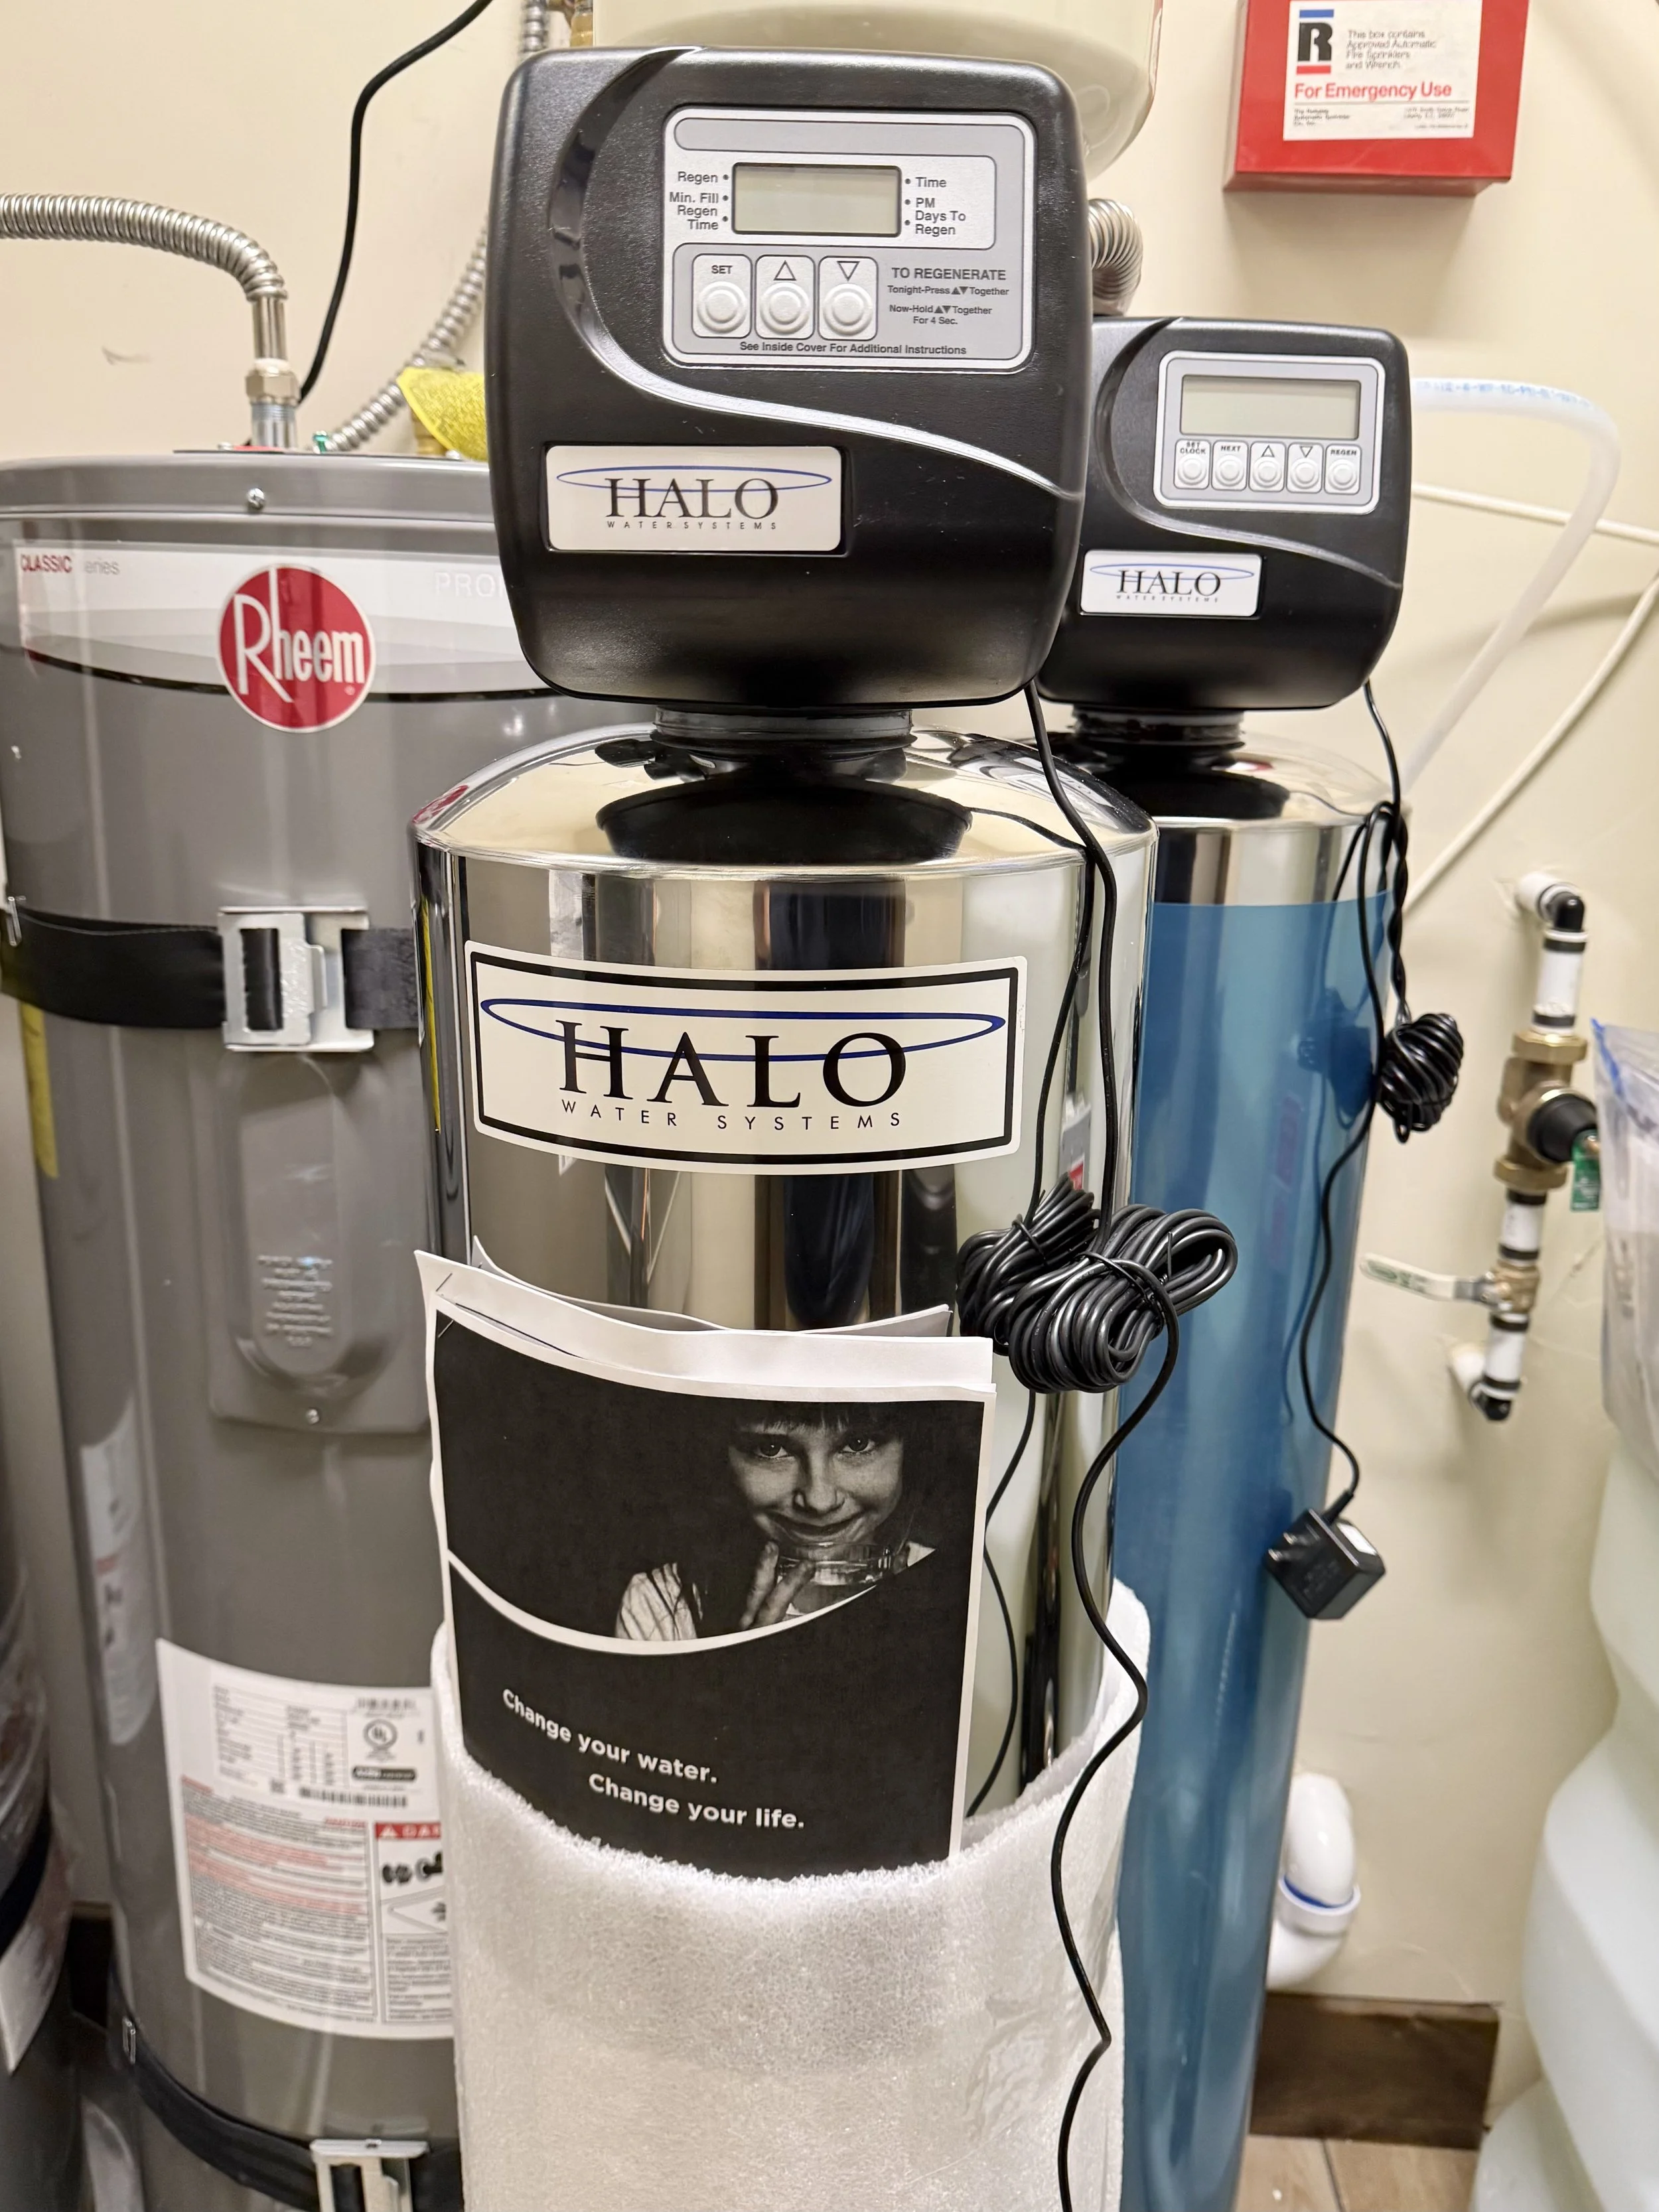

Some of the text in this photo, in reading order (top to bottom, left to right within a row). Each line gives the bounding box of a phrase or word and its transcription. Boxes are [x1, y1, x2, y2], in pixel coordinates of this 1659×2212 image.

[1295, 82, 1452, 102] For Emergency Use
[678, 171, 718, 183] Regen
[915, 176, 946, 188] Time
[669, 192, 719, 203] Min. Fill
[916, 198, 935, 208] PM
[677, 206, 717, 218] Regen
[915, 210, 966, 224] Days To
[687, 219, 719, 230] Time
[915, 224, 956, 236] Regen
[711, 265, 733, 275] SET
[891, 267, 1006, 280] TO REGENERATE
[887, 285, 1009, 297] Tonight-Press Together
[889, 305, 992, 316] Now-Hold Together
[913, 316, 958, 325] For 4 Sec.
[740, 342, 966, 355] See Inside Cover For Additional Instructions
[605, 478, 778, 519] HALO
[684, 521, 776, 530] SYSTEMS
[21, 555, 120, 575] CLASSIC eries
[1117, 570, 1221, 596] HALO
[234, 566, 365, 703] Rheem
[555, 1020, 906, 1108] HALO
[561, 1099, 901, 1131] WATER SYSTEMS
[502, 1689, 717, 1783] Change your water.
[589, 1773, 804, 1828] Change your life.
